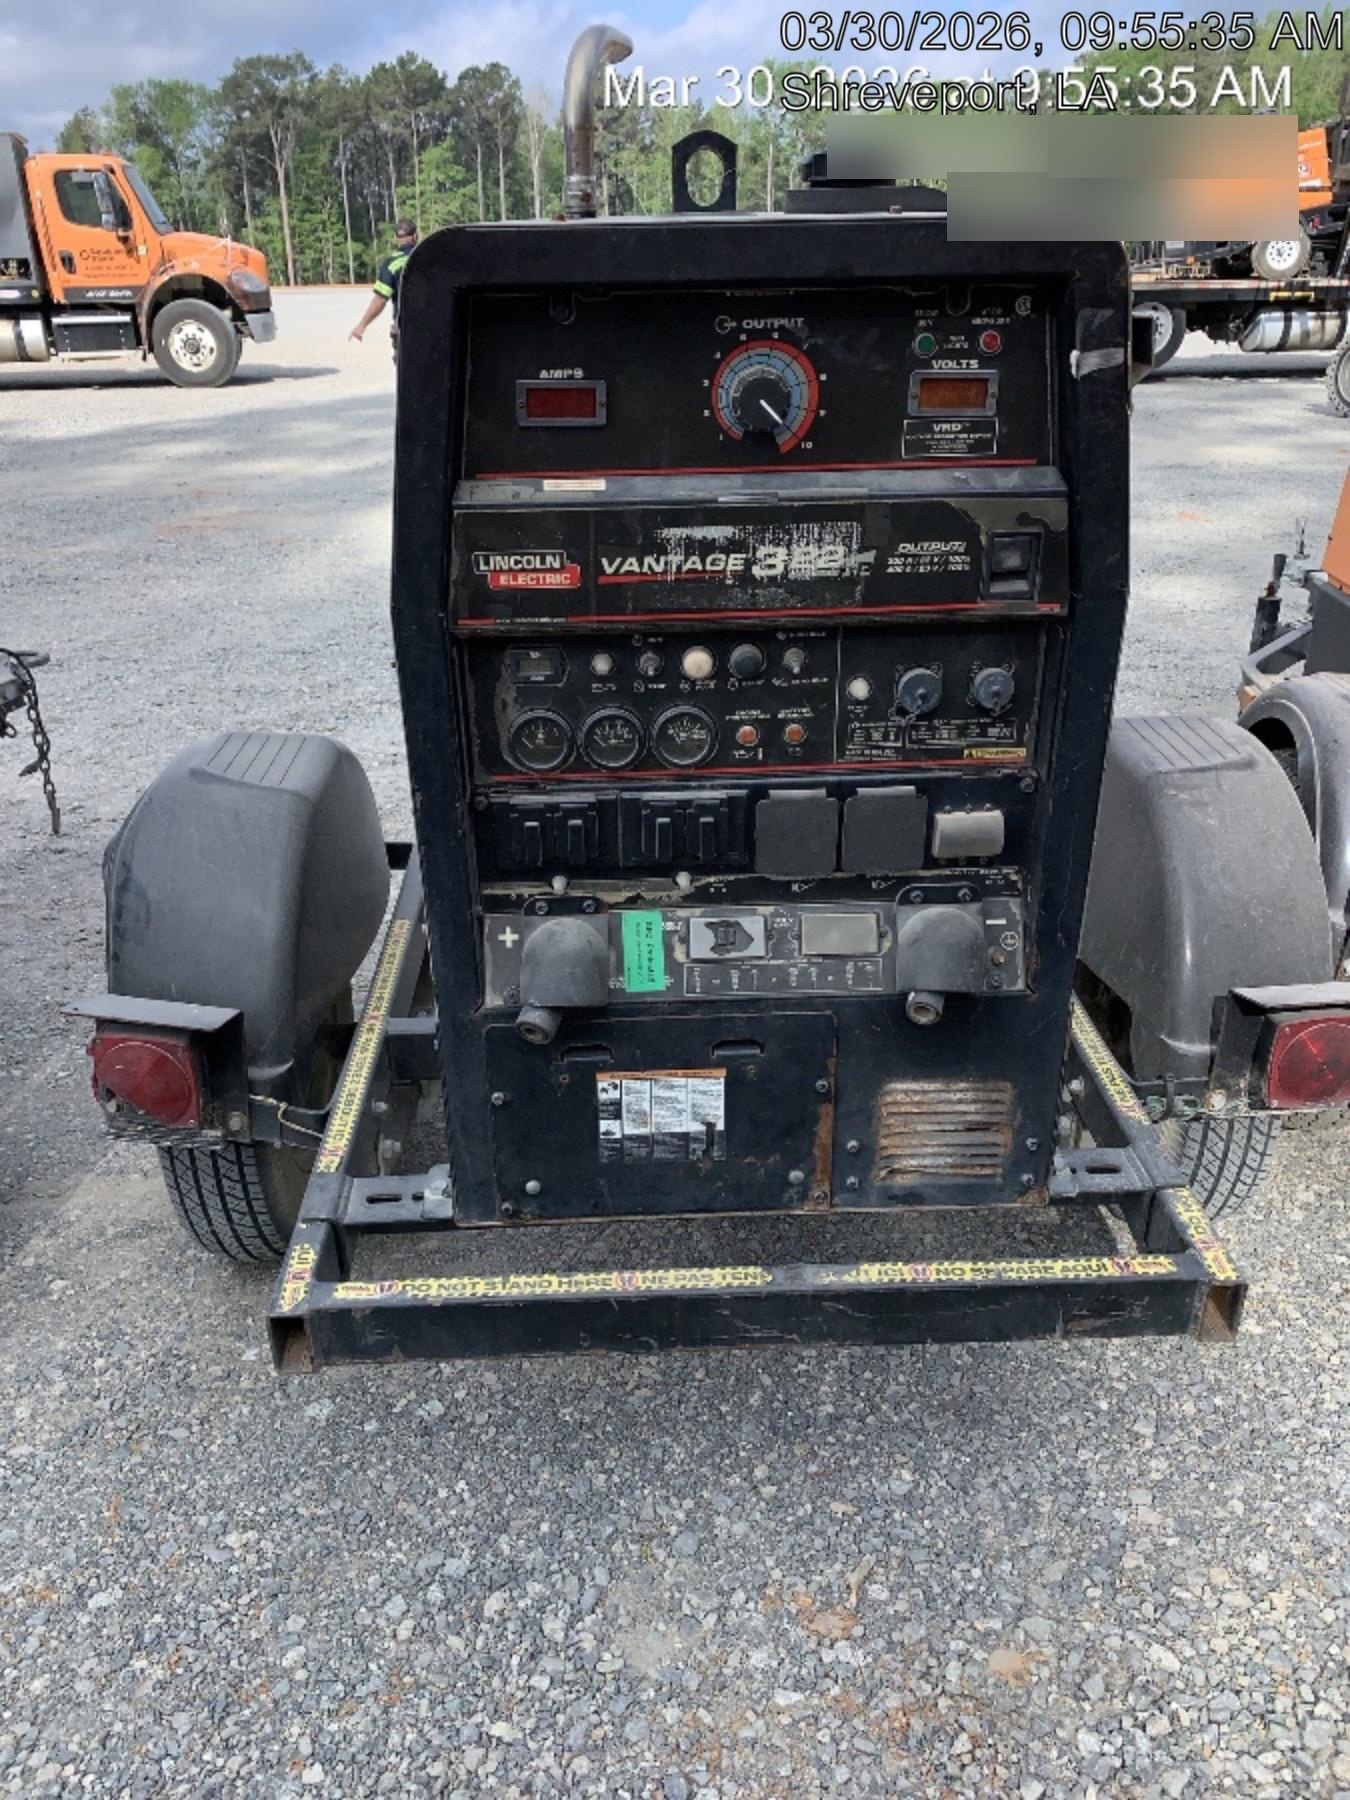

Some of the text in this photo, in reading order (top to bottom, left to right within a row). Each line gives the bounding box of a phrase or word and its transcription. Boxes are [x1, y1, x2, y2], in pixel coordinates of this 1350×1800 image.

[741, 317, 805, 329] OUTPUT
[931, 359, 979, 370] VOLTS
[479, 555, 561, 570] LINCOLN
[601, 553, 747, 575] VANTAGE
[500, 573, 572, 586] ELECTRIC
